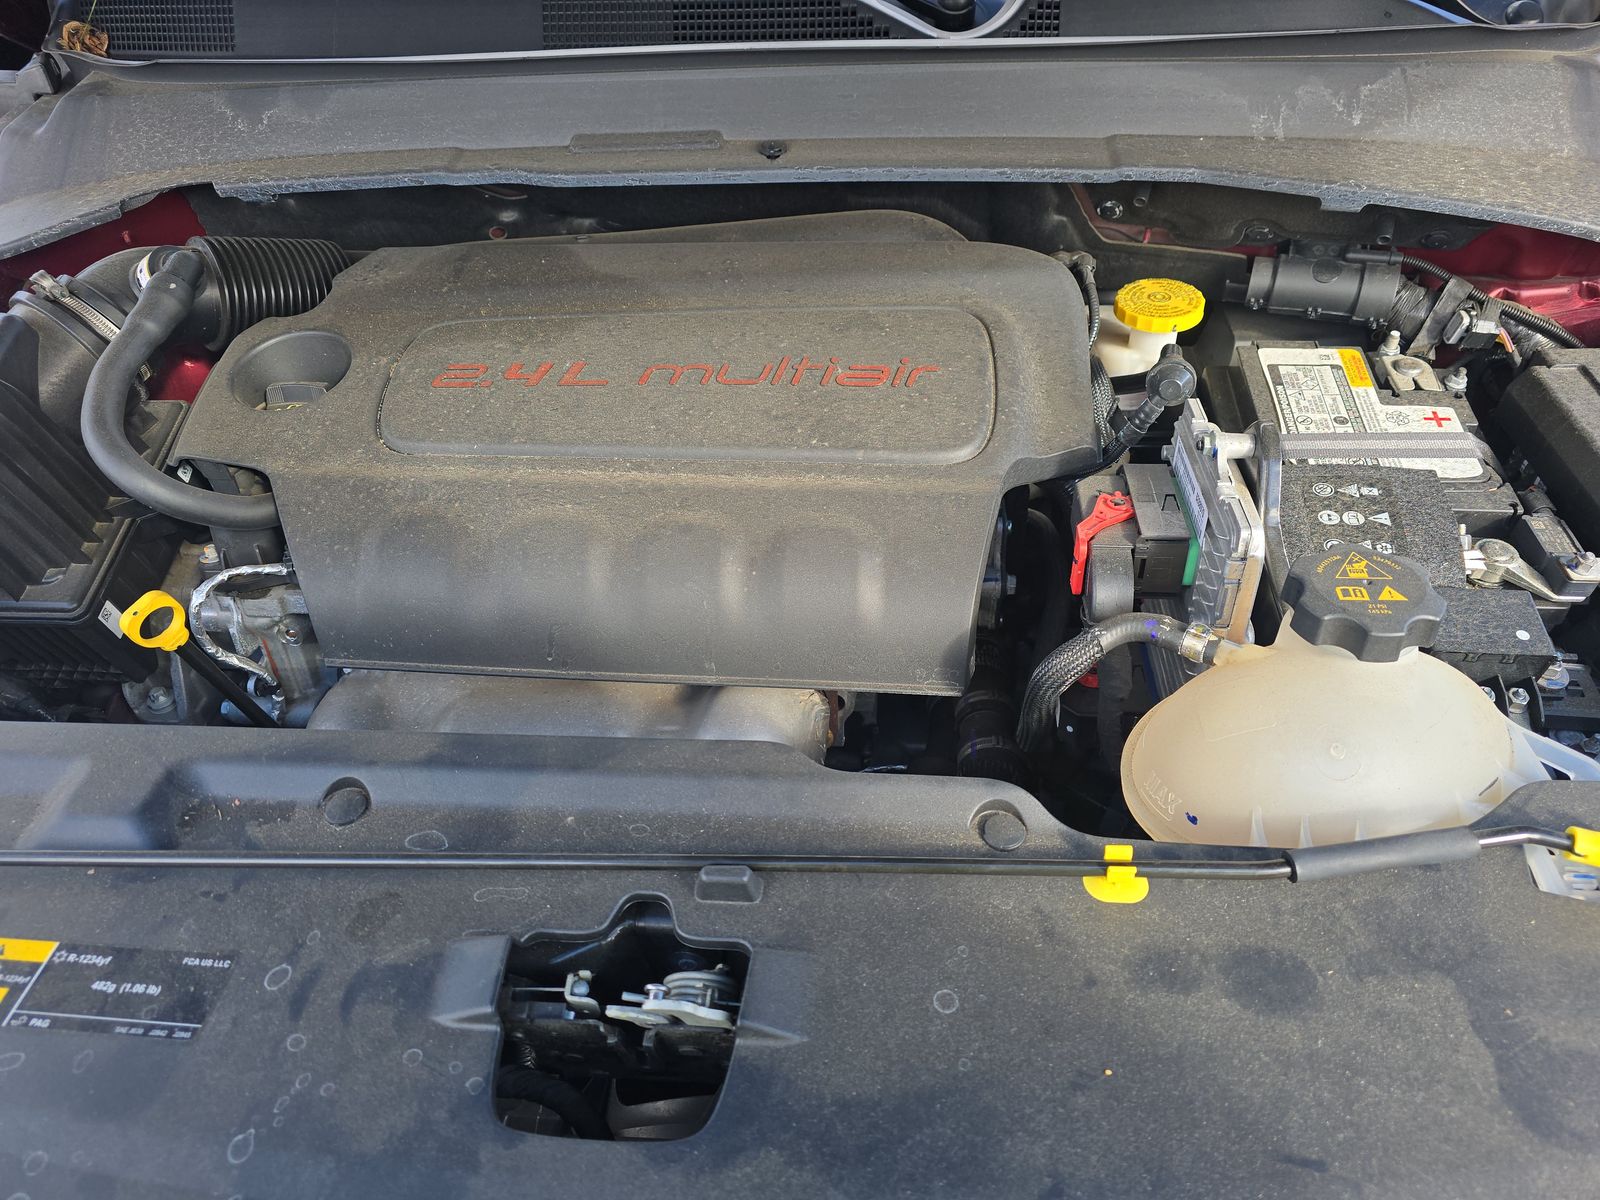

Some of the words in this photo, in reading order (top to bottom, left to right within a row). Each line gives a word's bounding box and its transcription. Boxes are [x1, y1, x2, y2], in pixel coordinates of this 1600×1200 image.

[637, 356, 942, 388] multiair
[67, 954, 113, 967] R-1234yf
[182, 957, 200, 966] FCA
[200, 958, 214, 967] US
[213, 959, 232, 969] LLC
[146, 984, 162, 997] lb)
[28, 1017, 52, 1028] PAG
